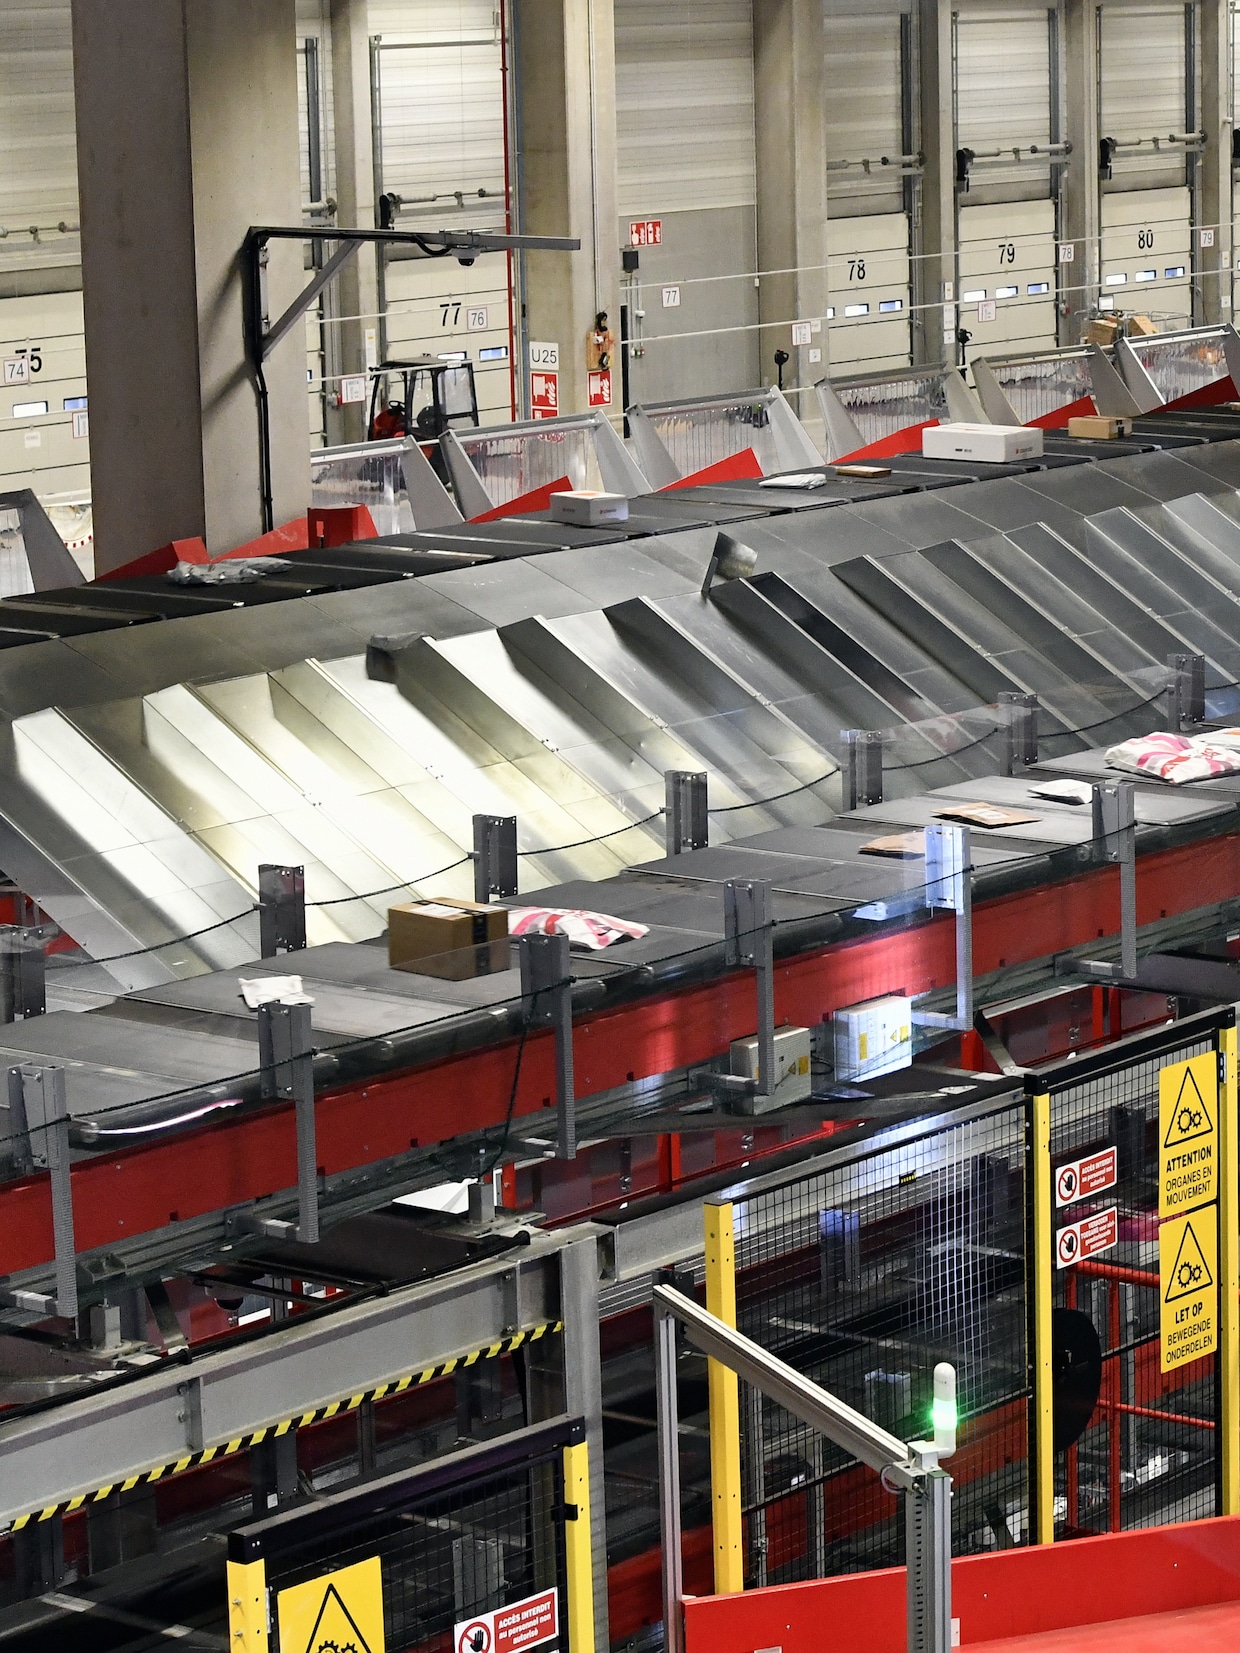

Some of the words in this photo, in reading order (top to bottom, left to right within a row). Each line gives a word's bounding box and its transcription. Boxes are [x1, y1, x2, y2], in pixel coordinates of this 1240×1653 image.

[1138, 229, 1154, 249] 80
[1202, 232, 1213, 245] 79
[998, 243, 1016, 264] 79
[1061, 247, 1073, 260] 78
[847, 259, 866, 281] 78
[665, 290, 677, 304] 77
[439, 302, 462, 327] 77
[470, 311, 485, 326] 76
[531, 350, 557, 364] U25
[8, 362, 25, 379] 74
[1166, 1145, 1212, 1173] ATTENTION
[1165, 1169, 1202, 1192] ORGANES
[1202, 1165, 1212, 1178] EN
[1166, 1180, 1211, 1206] MOUVEMENT
[1175, 1306, 1190, 1325] LET
[1192, 1302, 1203, 1317] OP
[1167, 1318, 1211, 1346] BEWEGENDE
[1165, 1334, 1213, 1363] ONDERDELEN
[498, 1613, 521, 1629] ACCÈS
